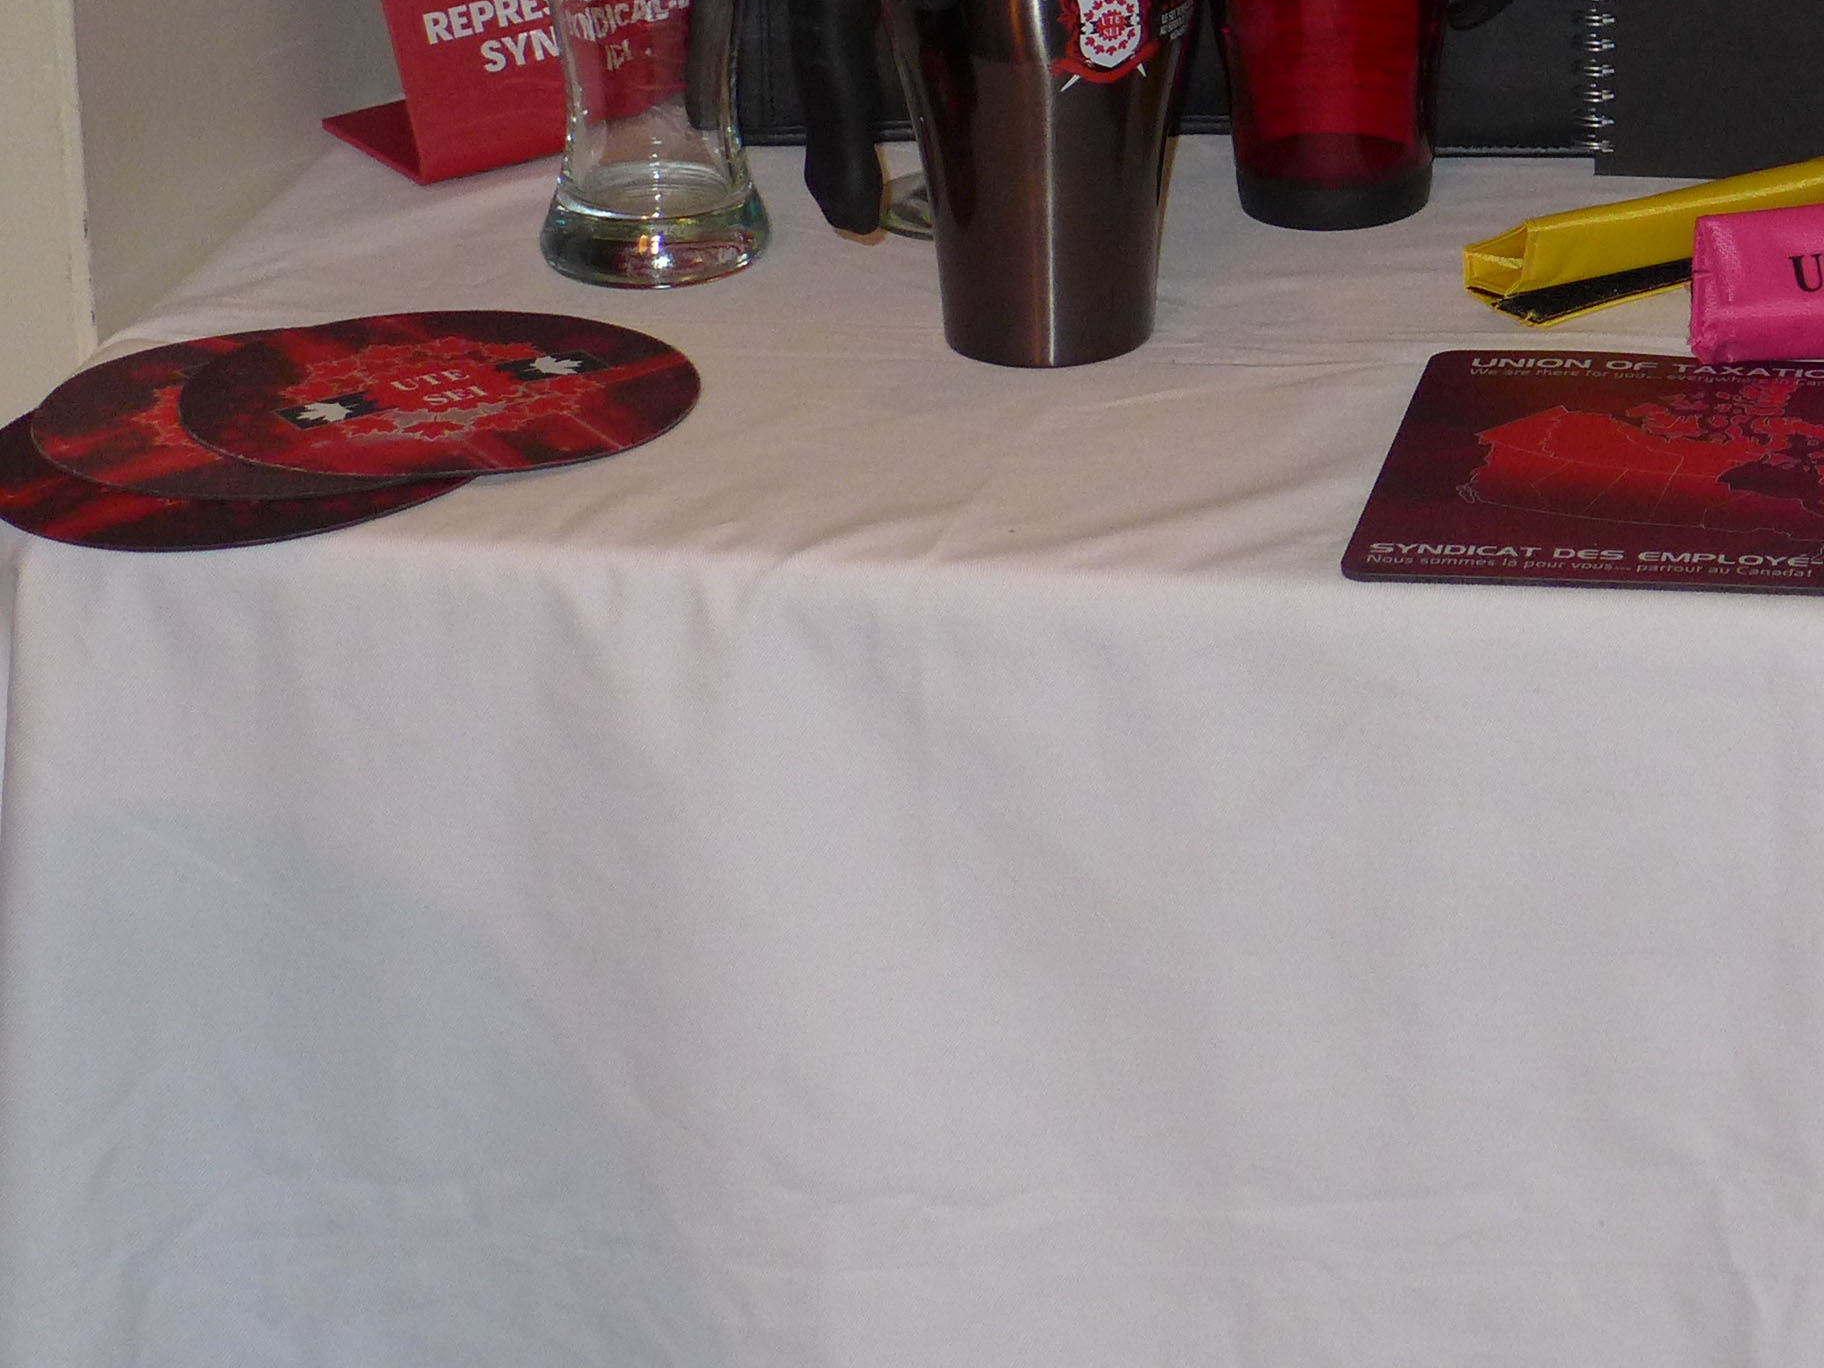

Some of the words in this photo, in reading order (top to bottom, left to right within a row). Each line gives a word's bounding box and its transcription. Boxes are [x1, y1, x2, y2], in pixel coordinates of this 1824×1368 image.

[1471, 357, 1593, 371] UNION
[1605, 359, 1659, 371] OF
[390, 368, 471, 391] UTE
[423, 385, 488, 406] SEI
[1369, 542, 1542, 557] SYNDICAT
[1552, 547, 1626, 561] DES
[1366, 554, 1414, 565] Nous
[1420, 557, 1496, 568] sommes
[1523, 560, 1564, 570] pour
[1636, 564, 1704, 574] partout
[1708, 566, 1731, 575] au
[1736, 567, 1813, 578] Canada!
